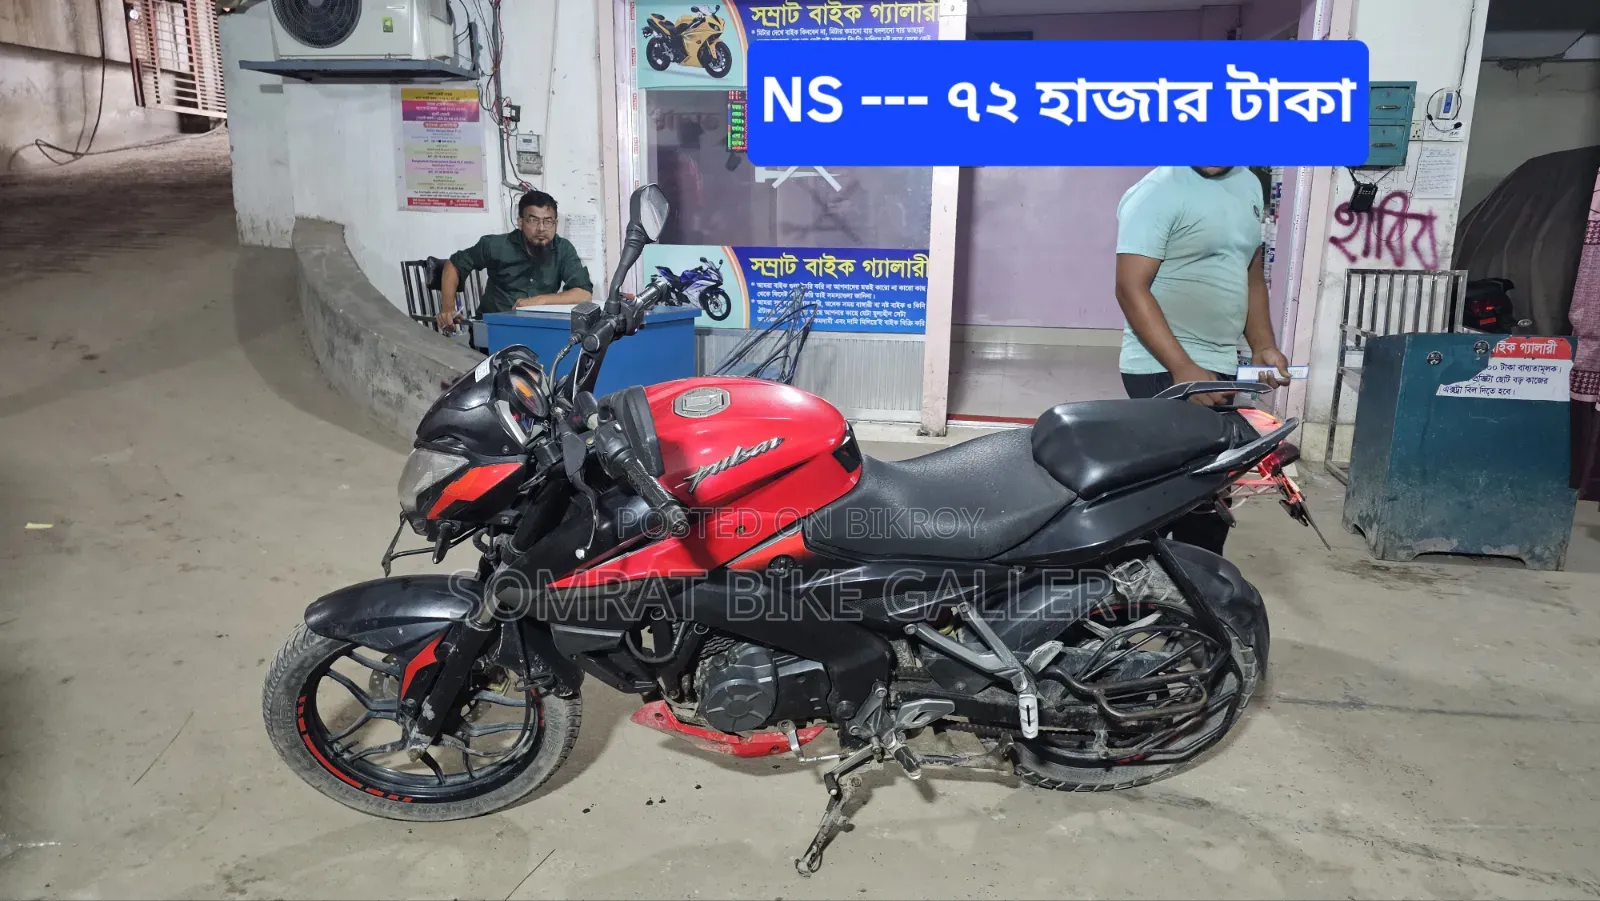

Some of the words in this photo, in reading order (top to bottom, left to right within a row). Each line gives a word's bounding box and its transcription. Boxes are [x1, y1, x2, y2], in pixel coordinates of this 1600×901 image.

[749, 0, 802, 29] সম্রাট
[806, 0, 864, 27] বাইক
[749, 252, 799, 279] সম্রাট
[803, 253, 857, 279] বাইক
[862, 253, 929, 279] গ্যালারী
[1520, 340, 1558, 355] গ্যালারী
[1500, 362, 1516, 372] টাকা
[1495, 375, 1511, 383] ছোট
[1525, 376, 1549, 385] কাজের
[1464, 386, 1477, 394] বিল
[1480, 386, 1495, 396] দিতে
